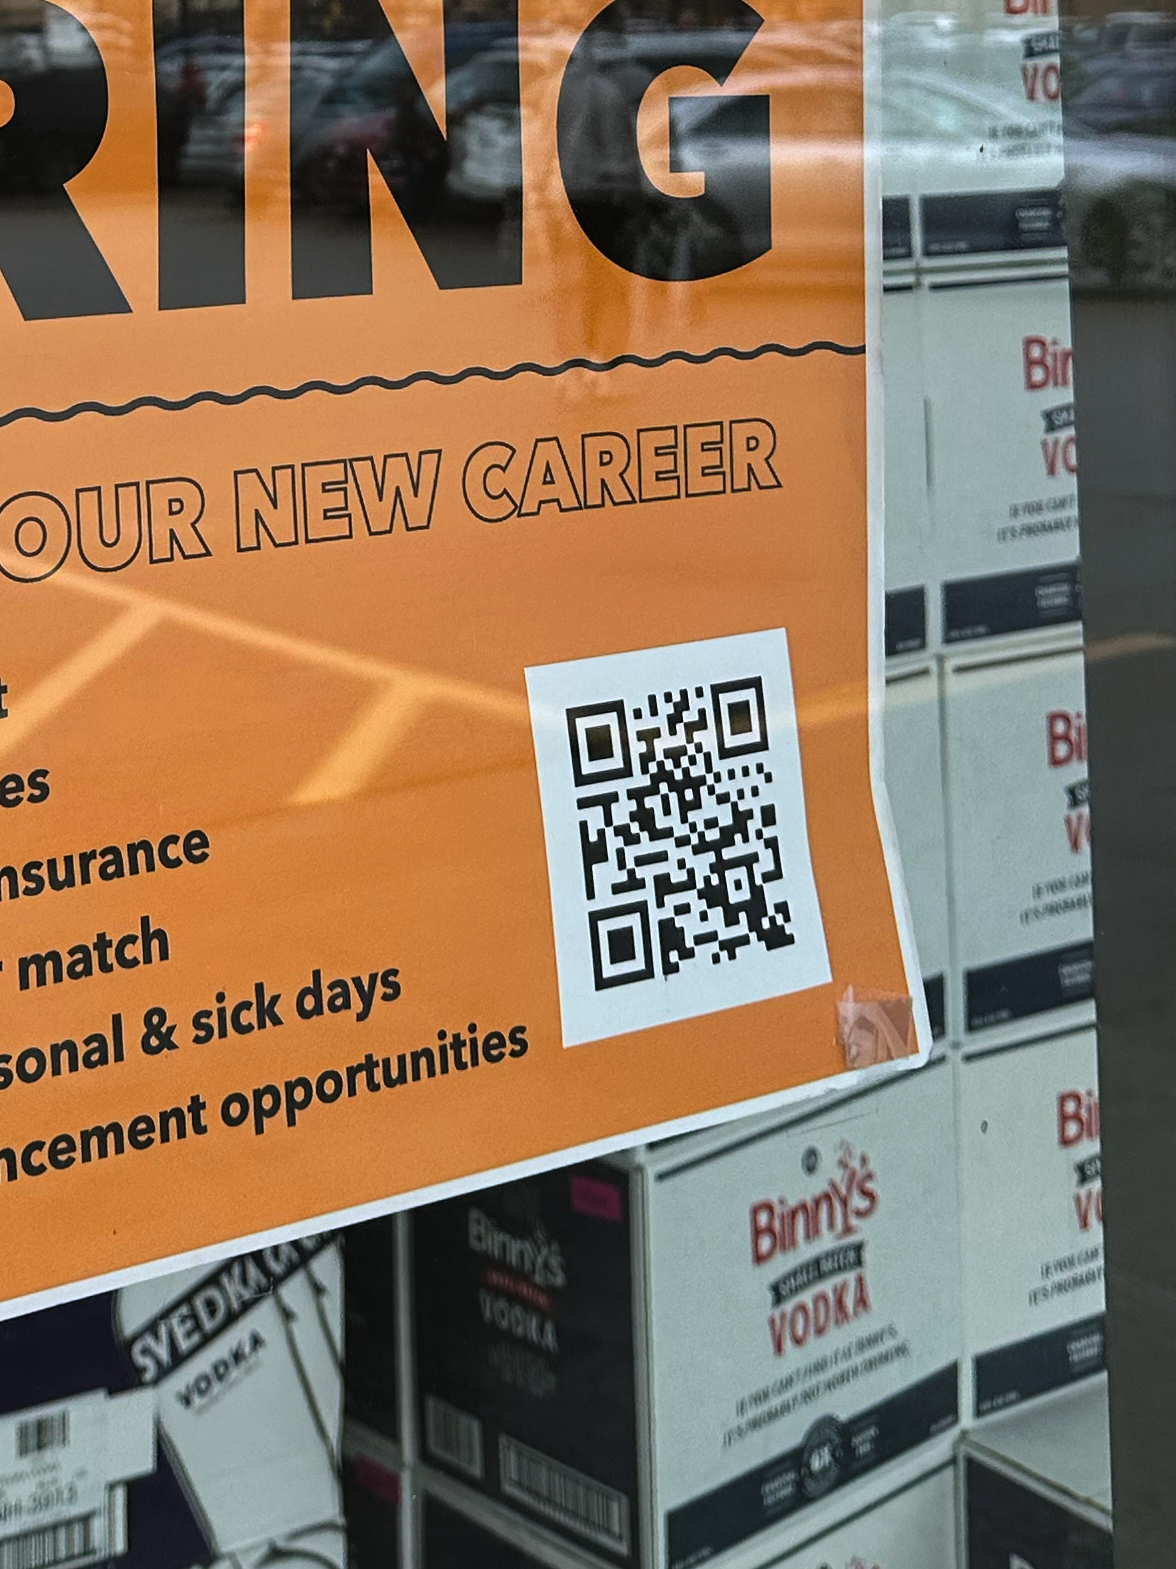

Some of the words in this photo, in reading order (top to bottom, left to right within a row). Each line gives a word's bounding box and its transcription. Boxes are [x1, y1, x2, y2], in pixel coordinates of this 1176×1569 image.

[234, 449, 441, 553] NEW
[461, 417, 783, 522] CAREER
[18, 915, 170, 991] match
[141, 1007, 180, 1055] &
[192, 982, 283, 1044] sick
[296, 967, 402, 1021] days
[220, 1022, 529, 1135] opportunities
[131, 1254, 273, 1383] SVEDKA
[769, 1273, 871, 1357] VODKA
[176, 1328, 267, 1409] VODKA
